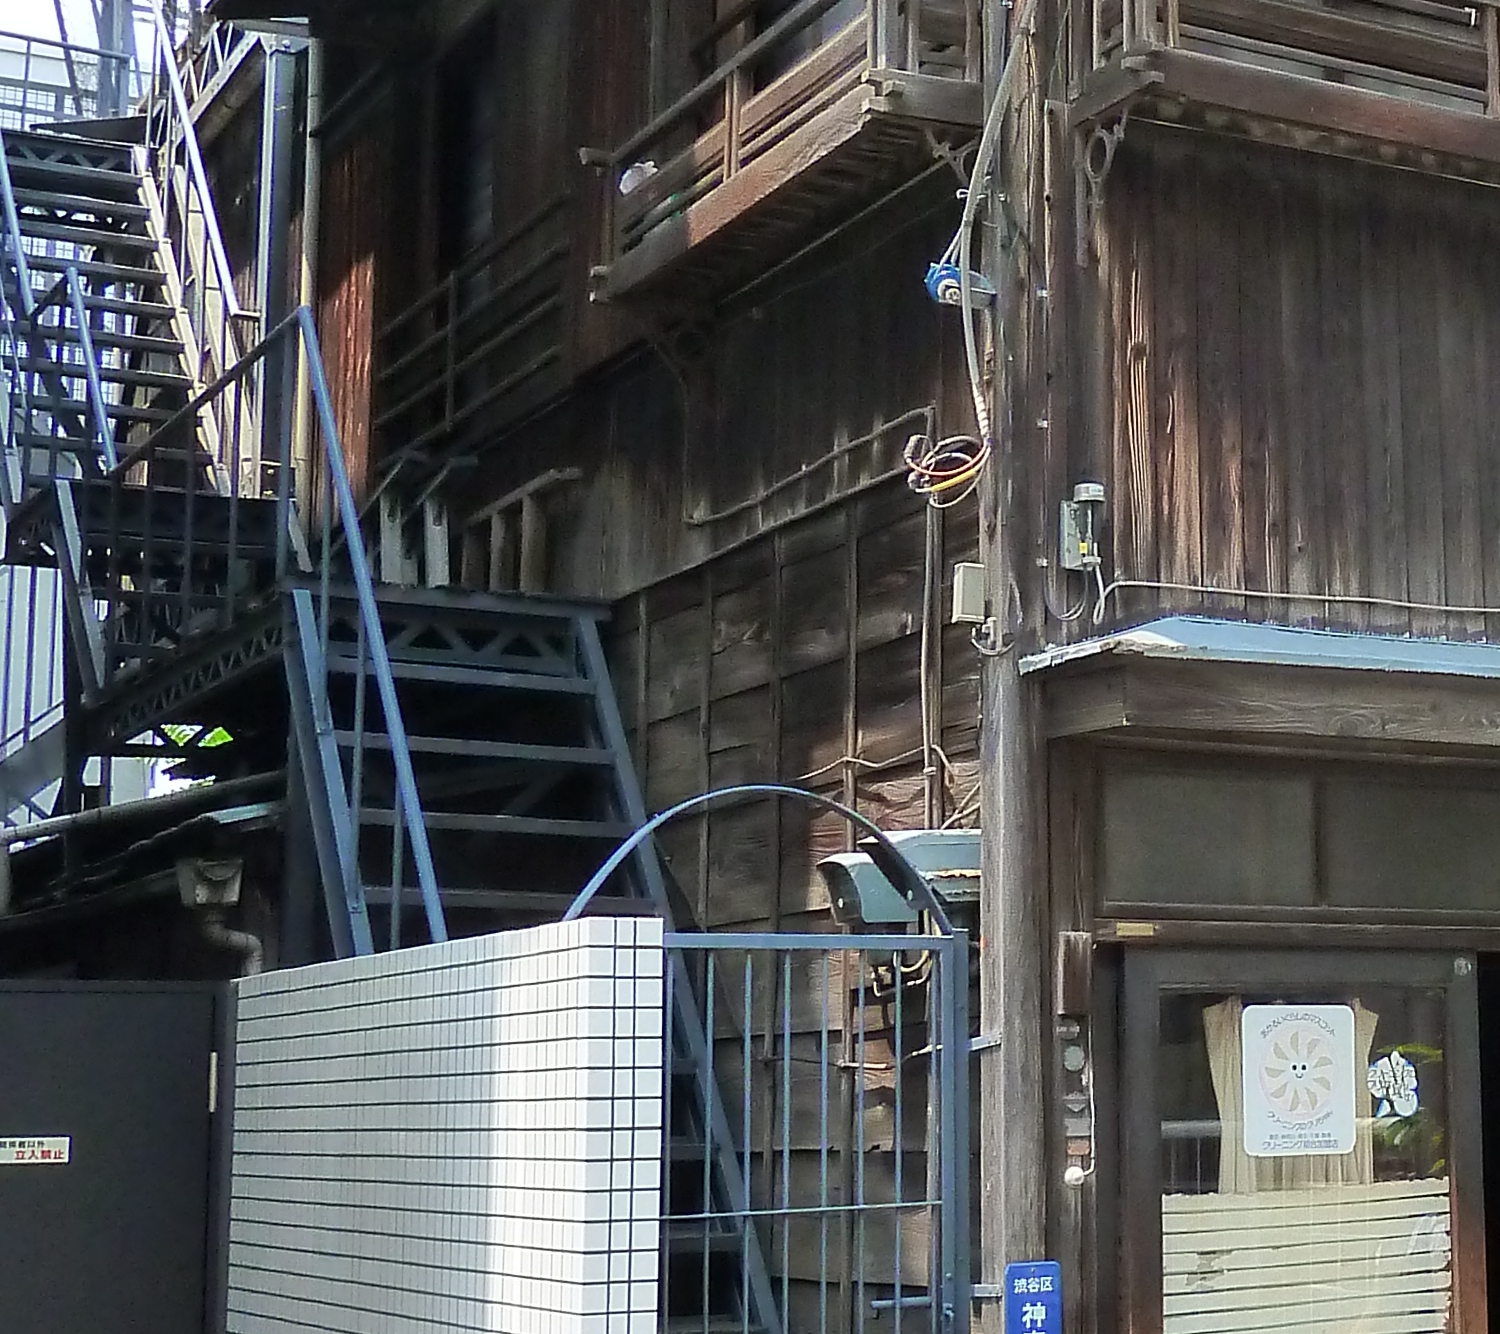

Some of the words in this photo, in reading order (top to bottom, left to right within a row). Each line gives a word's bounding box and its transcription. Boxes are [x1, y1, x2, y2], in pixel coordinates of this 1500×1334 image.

[14, 1149, 65, 1160] 立入禁止
[1013, 1276, 1054, 1294] 渋谷区
